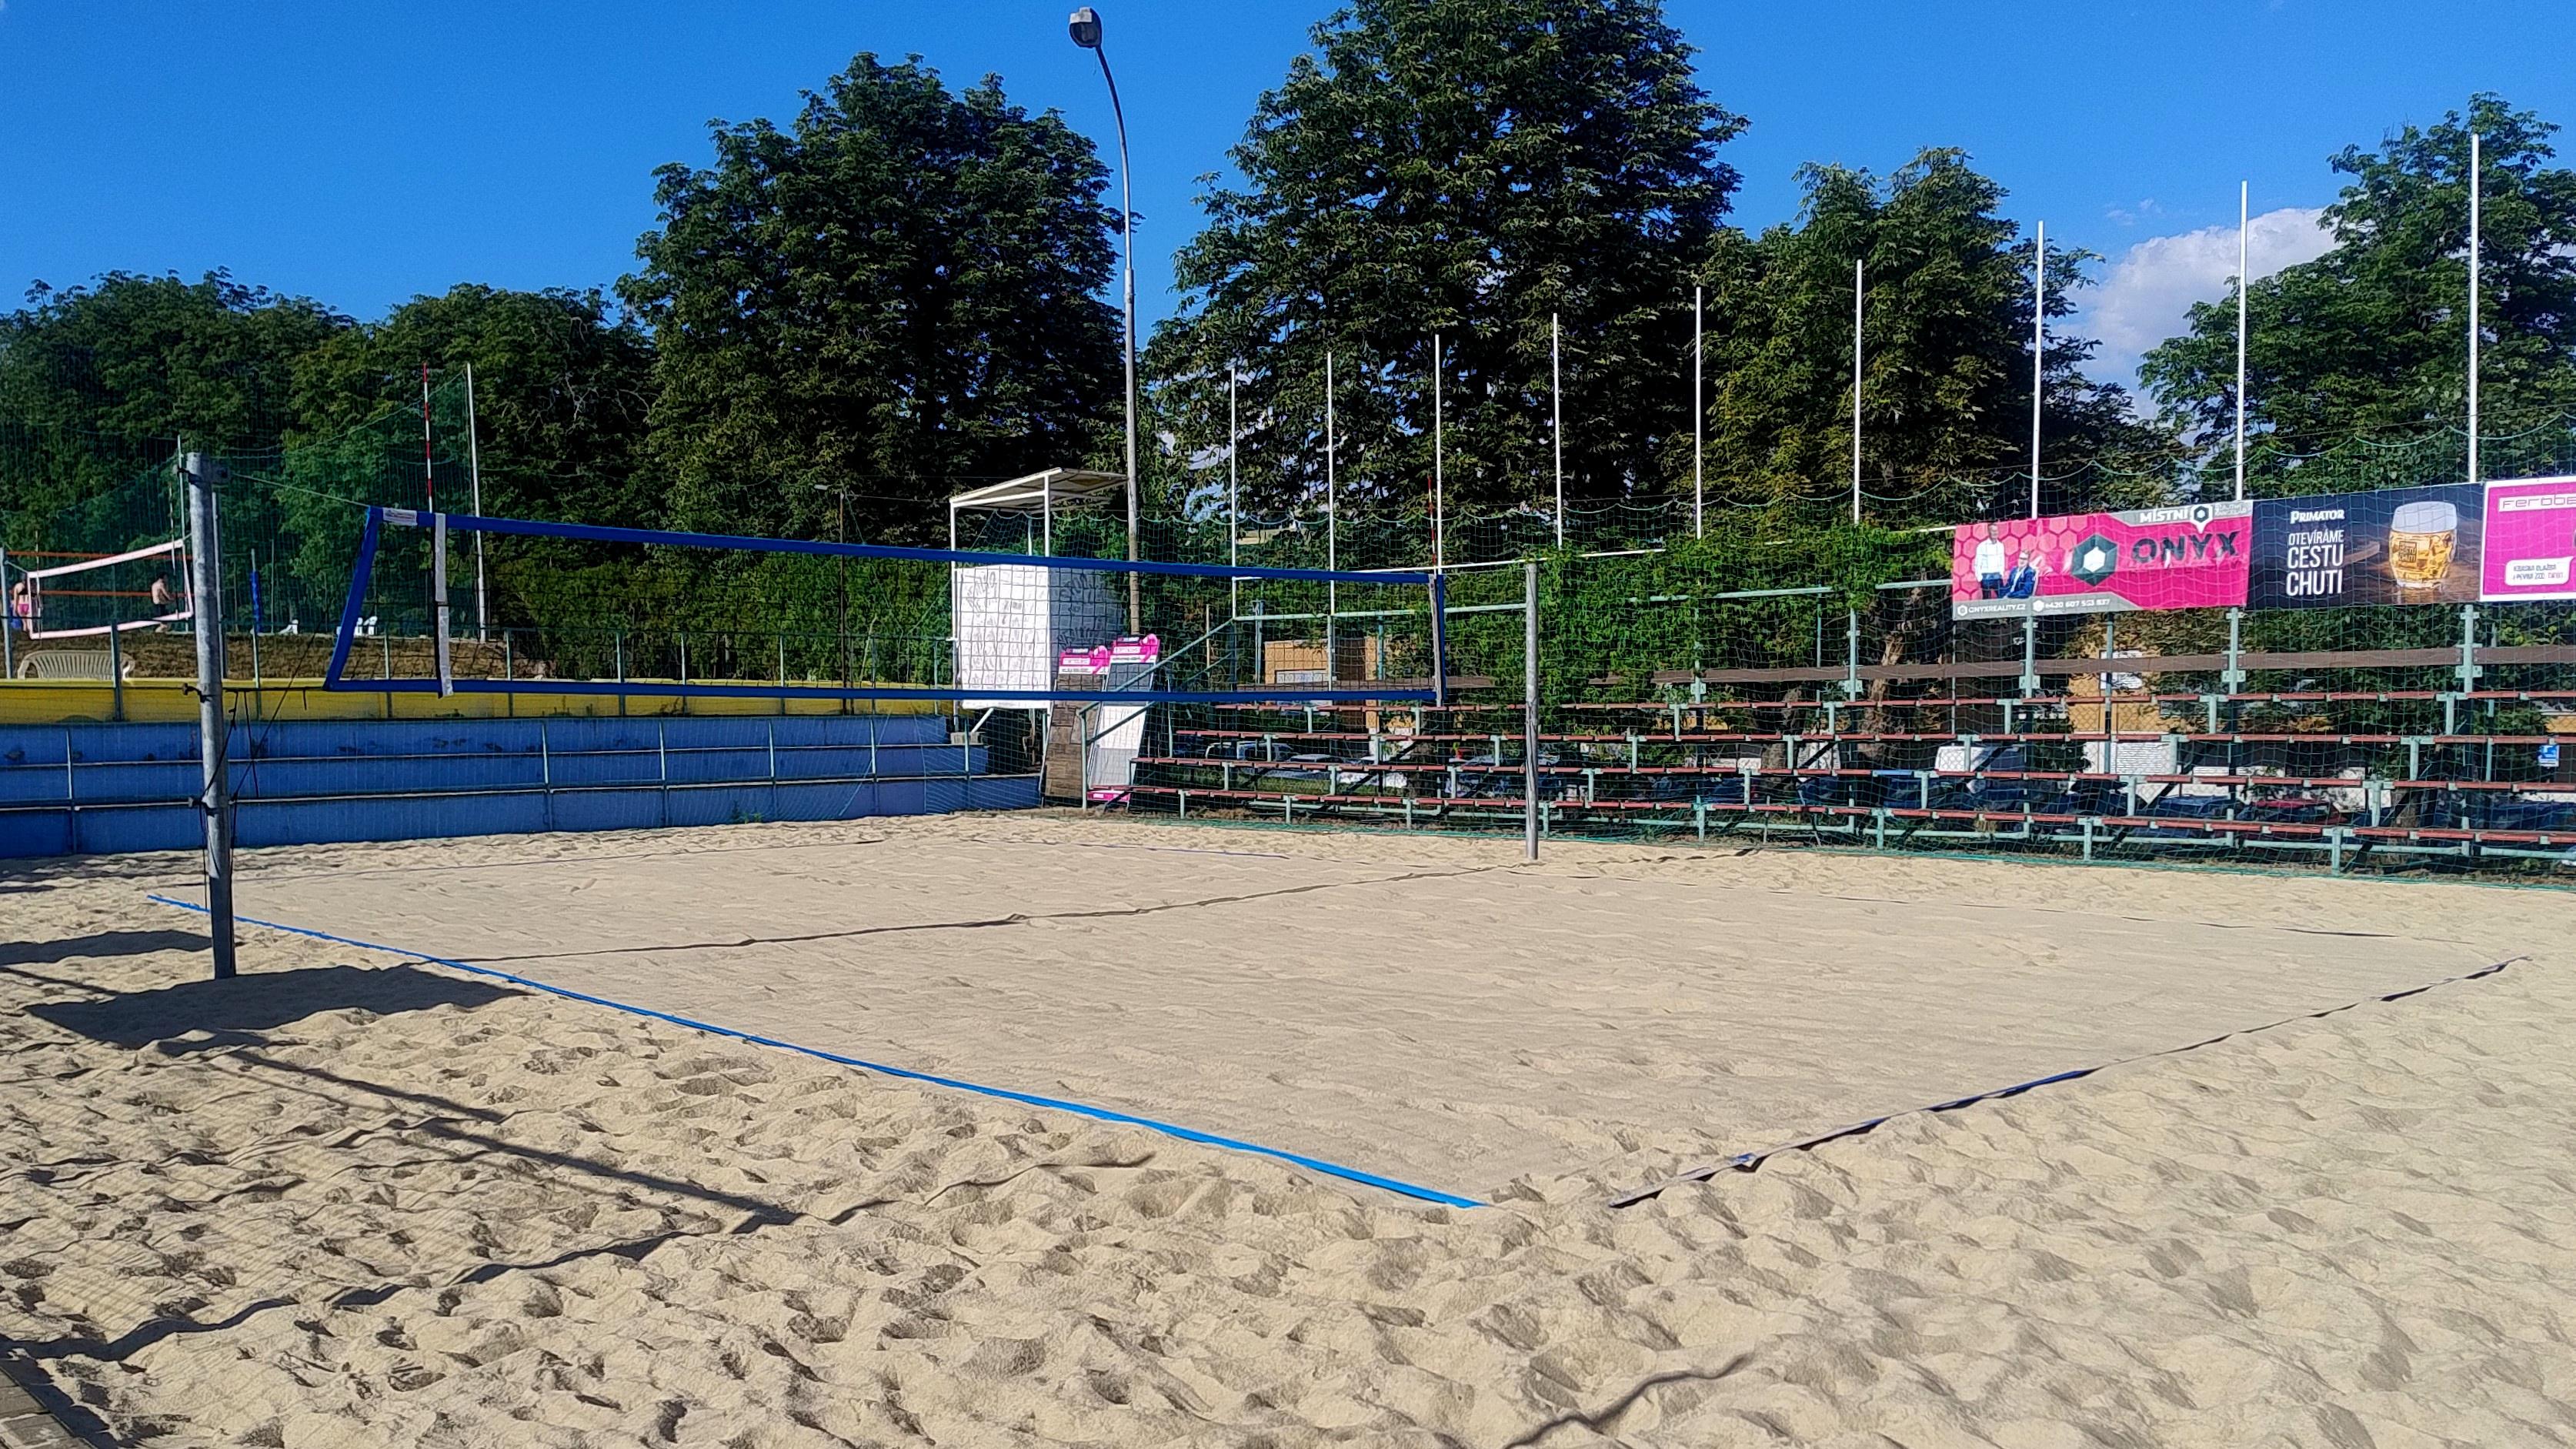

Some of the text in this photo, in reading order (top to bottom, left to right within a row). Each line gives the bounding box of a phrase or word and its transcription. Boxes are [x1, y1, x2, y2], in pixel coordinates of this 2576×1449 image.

[2290, 509, 2345, 524] PRIMATOR
[2132, 530, 2241, 563] ONYX
[2288, 529, 2344, 546] OTEVÍRÁME
[2287, 543, 2344, 569] CESTU
[2286, 569, 2343, 596] CHUTI
